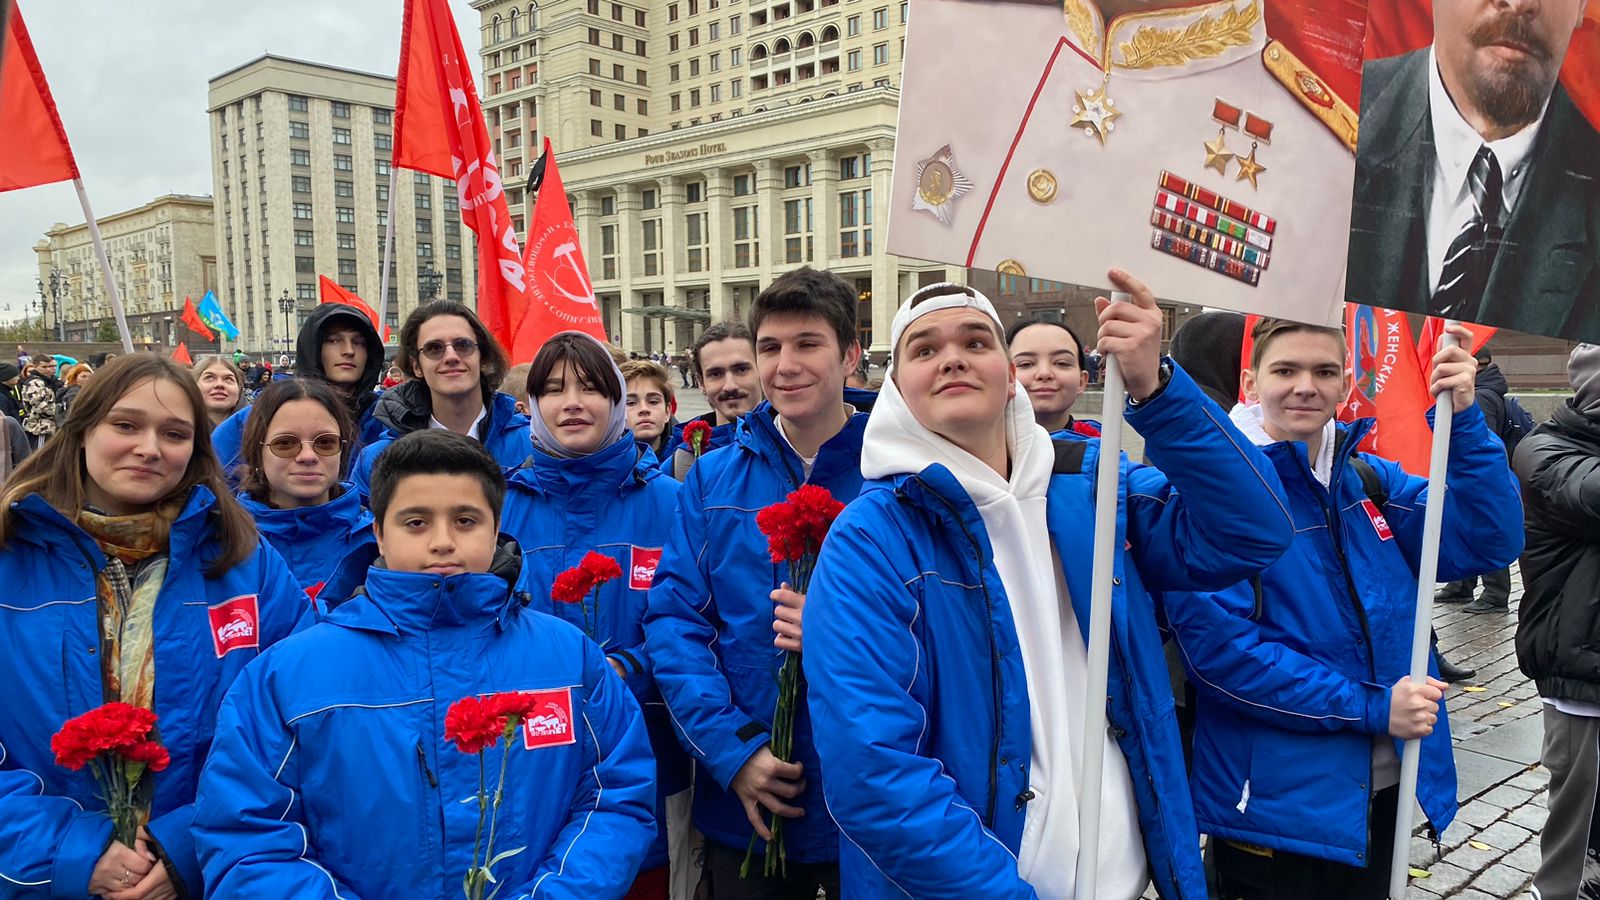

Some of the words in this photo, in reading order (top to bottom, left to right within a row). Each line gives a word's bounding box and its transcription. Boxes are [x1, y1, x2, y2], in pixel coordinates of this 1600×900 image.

[645, 154, 664, 166] FOUR
[665, 148, 699, 161] SEASONS
[700, 142, 727, 155] HOTEL
[1375, 322, 1399, 393] ЖЕНСКИЙ
